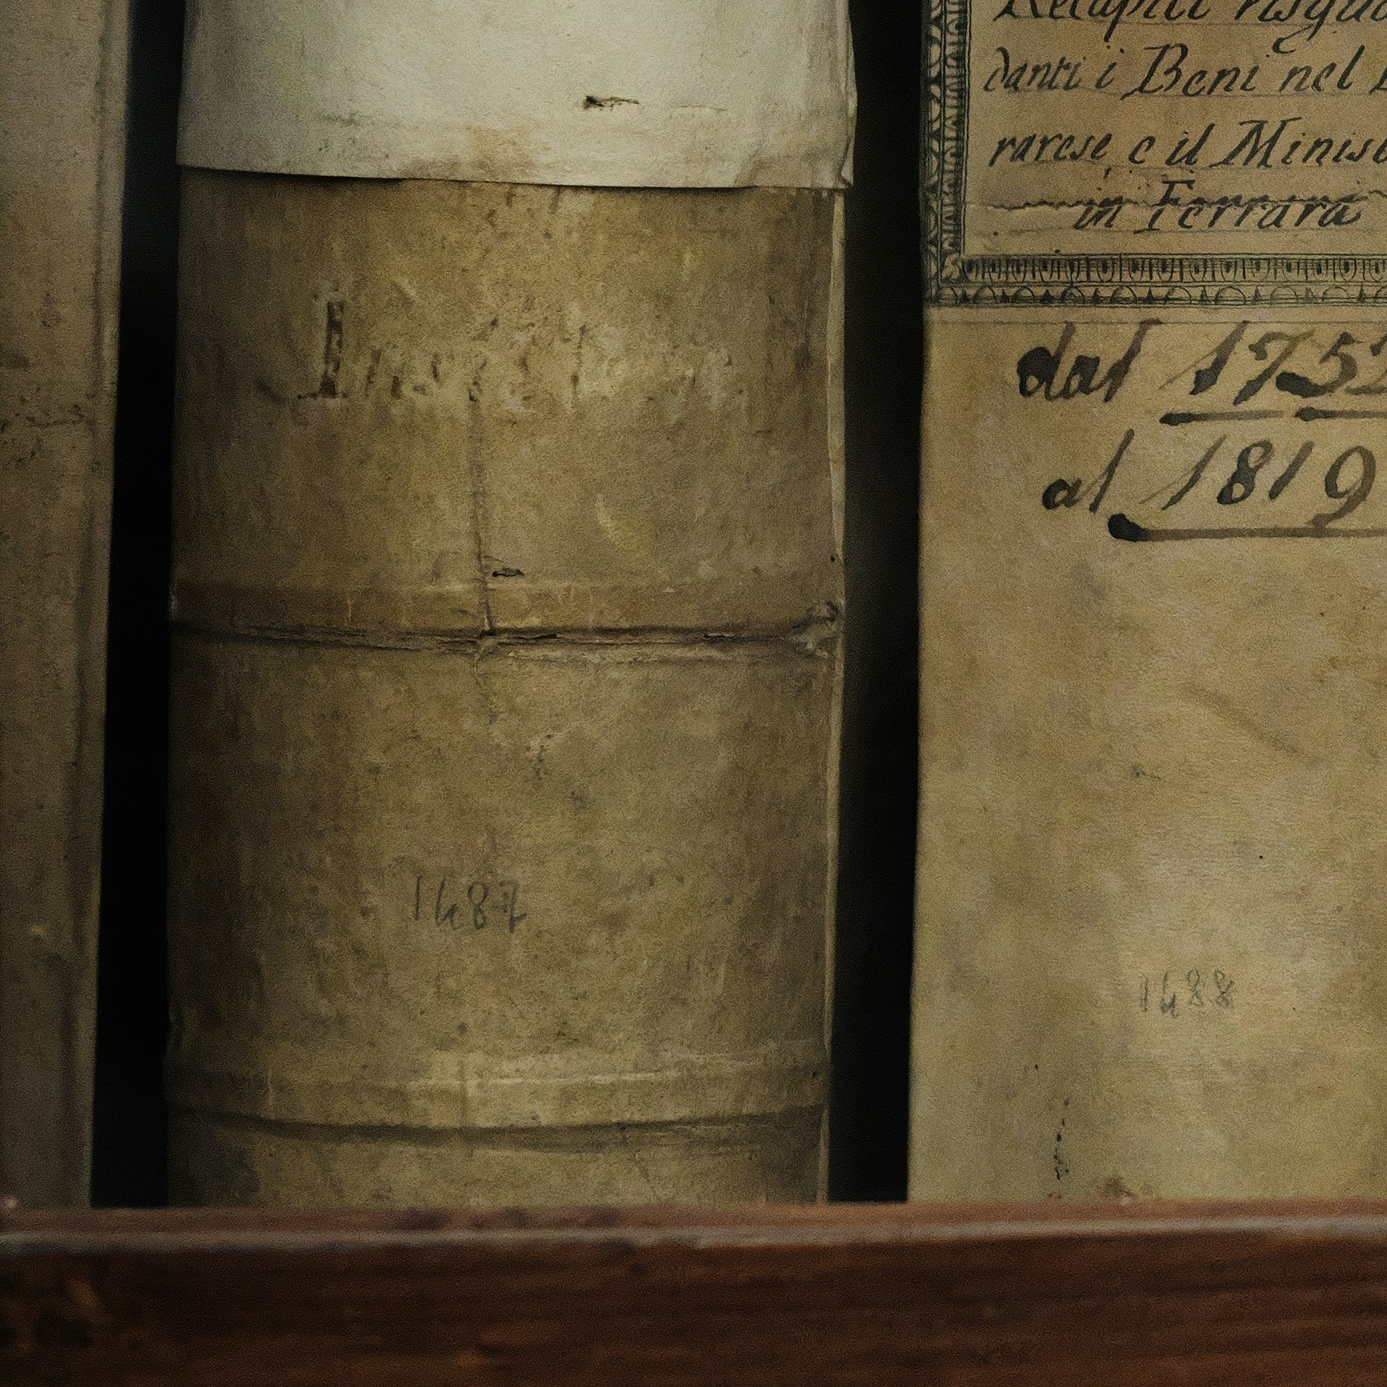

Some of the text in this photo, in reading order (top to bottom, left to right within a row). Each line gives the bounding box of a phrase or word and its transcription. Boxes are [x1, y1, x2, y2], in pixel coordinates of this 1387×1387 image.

[1120, 42, 1262, 101] Beni
[1278, 44, 1366, 94] nel
[1015, 319, 1164, 402] dal
[1041, 428, 1378, 529] al 1819
